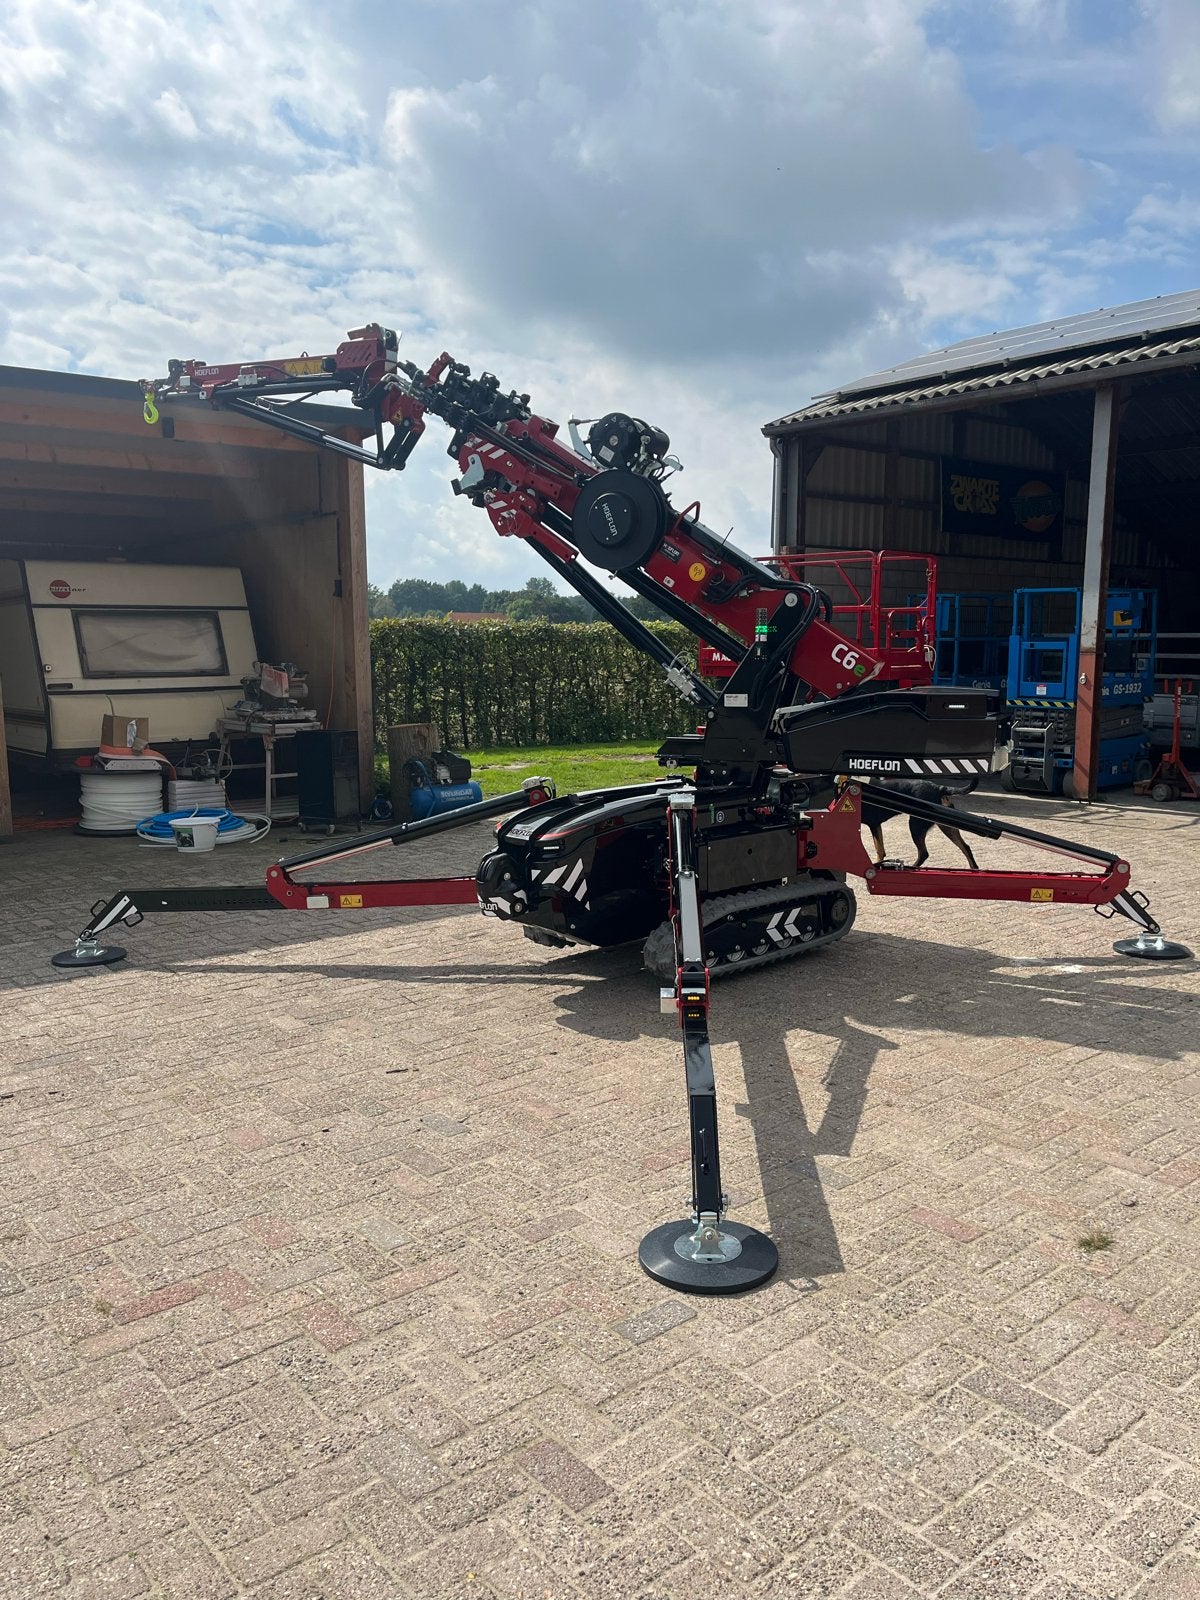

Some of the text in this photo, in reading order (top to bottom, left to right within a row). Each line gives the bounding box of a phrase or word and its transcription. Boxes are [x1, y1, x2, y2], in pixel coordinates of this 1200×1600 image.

[194, 368, 219, 377] HOEFLON
[950, 474, 1000, 496] ZWARTE
[602, 503, 618, 536] HOEFLON
[831, 643, 866, 677] C6e
[1113, 682, 1142, 695] GS-1932
[849, 758, 901, 772] HOEFLON
